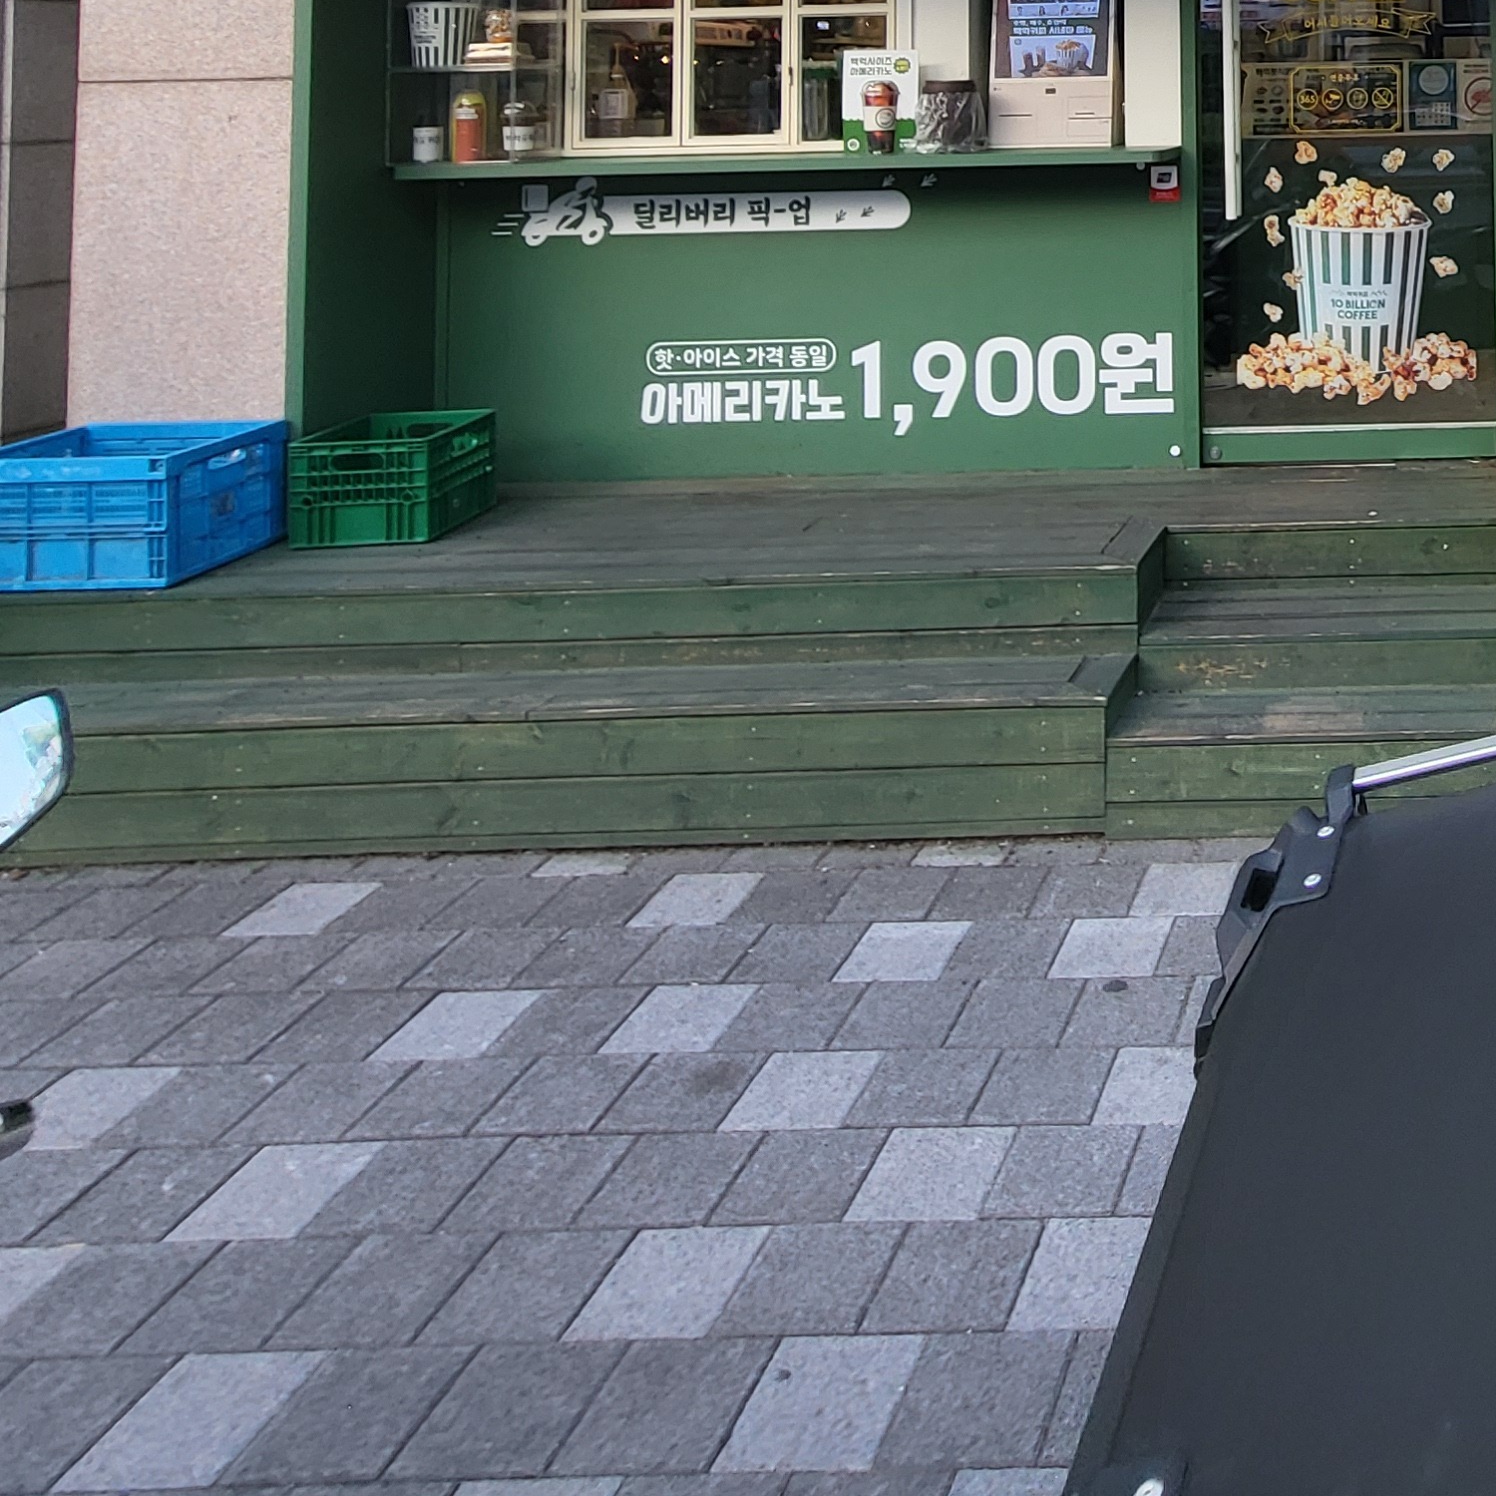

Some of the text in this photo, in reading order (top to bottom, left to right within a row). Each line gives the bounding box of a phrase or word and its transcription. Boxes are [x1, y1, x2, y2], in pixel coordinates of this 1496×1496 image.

[633, 197, 736, 229] 딜리버리
[1331, 298, 1386, 309] 10 BILLION
[1337, 310, 1378, 320] COFFEE
[744, 346, 785, 368] 가격
[788, 345, 828, 368] 동일
[850, 332, 1175, 436] 1,900원
[640, 379, 846, 425] 아메리카노
